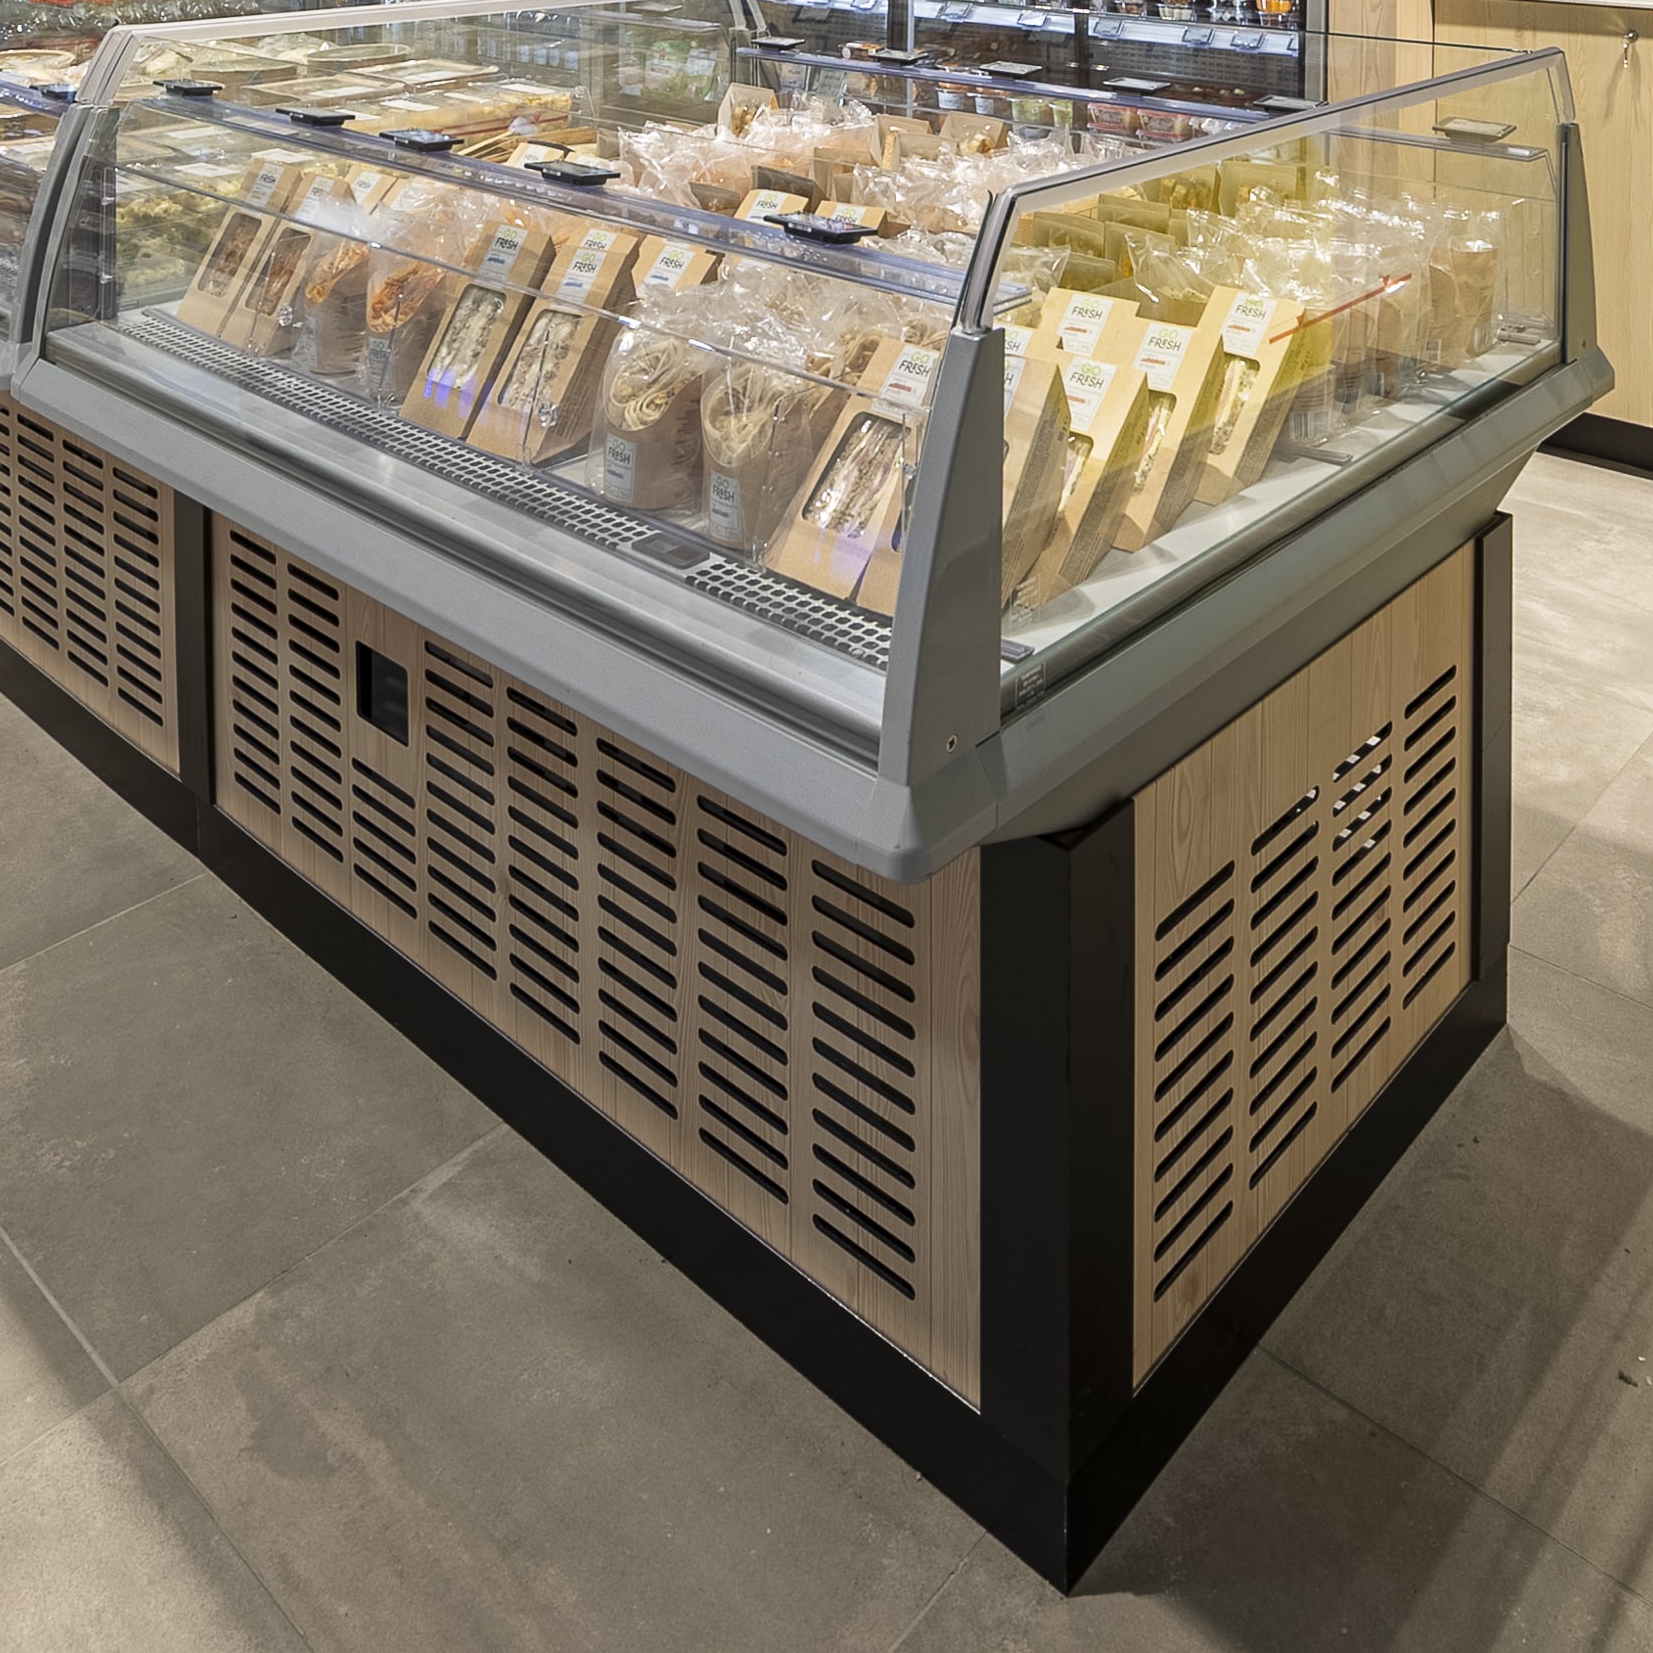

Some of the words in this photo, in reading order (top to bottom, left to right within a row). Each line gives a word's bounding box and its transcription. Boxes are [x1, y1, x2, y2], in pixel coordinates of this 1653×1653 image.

[756, 199, 778, 211] FRESH
[495, 236, 519, 251] FRESH
[584, 240, 607, 251] FRESH
[571, 260, 597, 274] FRESH
[659, 256, 684, 270] FRESH
[1071, 306, 1104, 321] FRESH
[1234, 304, 1267, 320] FRESH
[1158, 328, 1179, 340] GO
[1147, 336, 1182, 352] FRESH
[910, 351, 930, 364] GO
[898, 360, 931, 378] FRESH
[1082, 362, 1102, 376] GO
[1069, 372, 1104, 389] FRESH
[607, 447, 631, 465] FRESH
[715, 476, 730, 489] GO
[712, 484, 736, 503] FRESH
